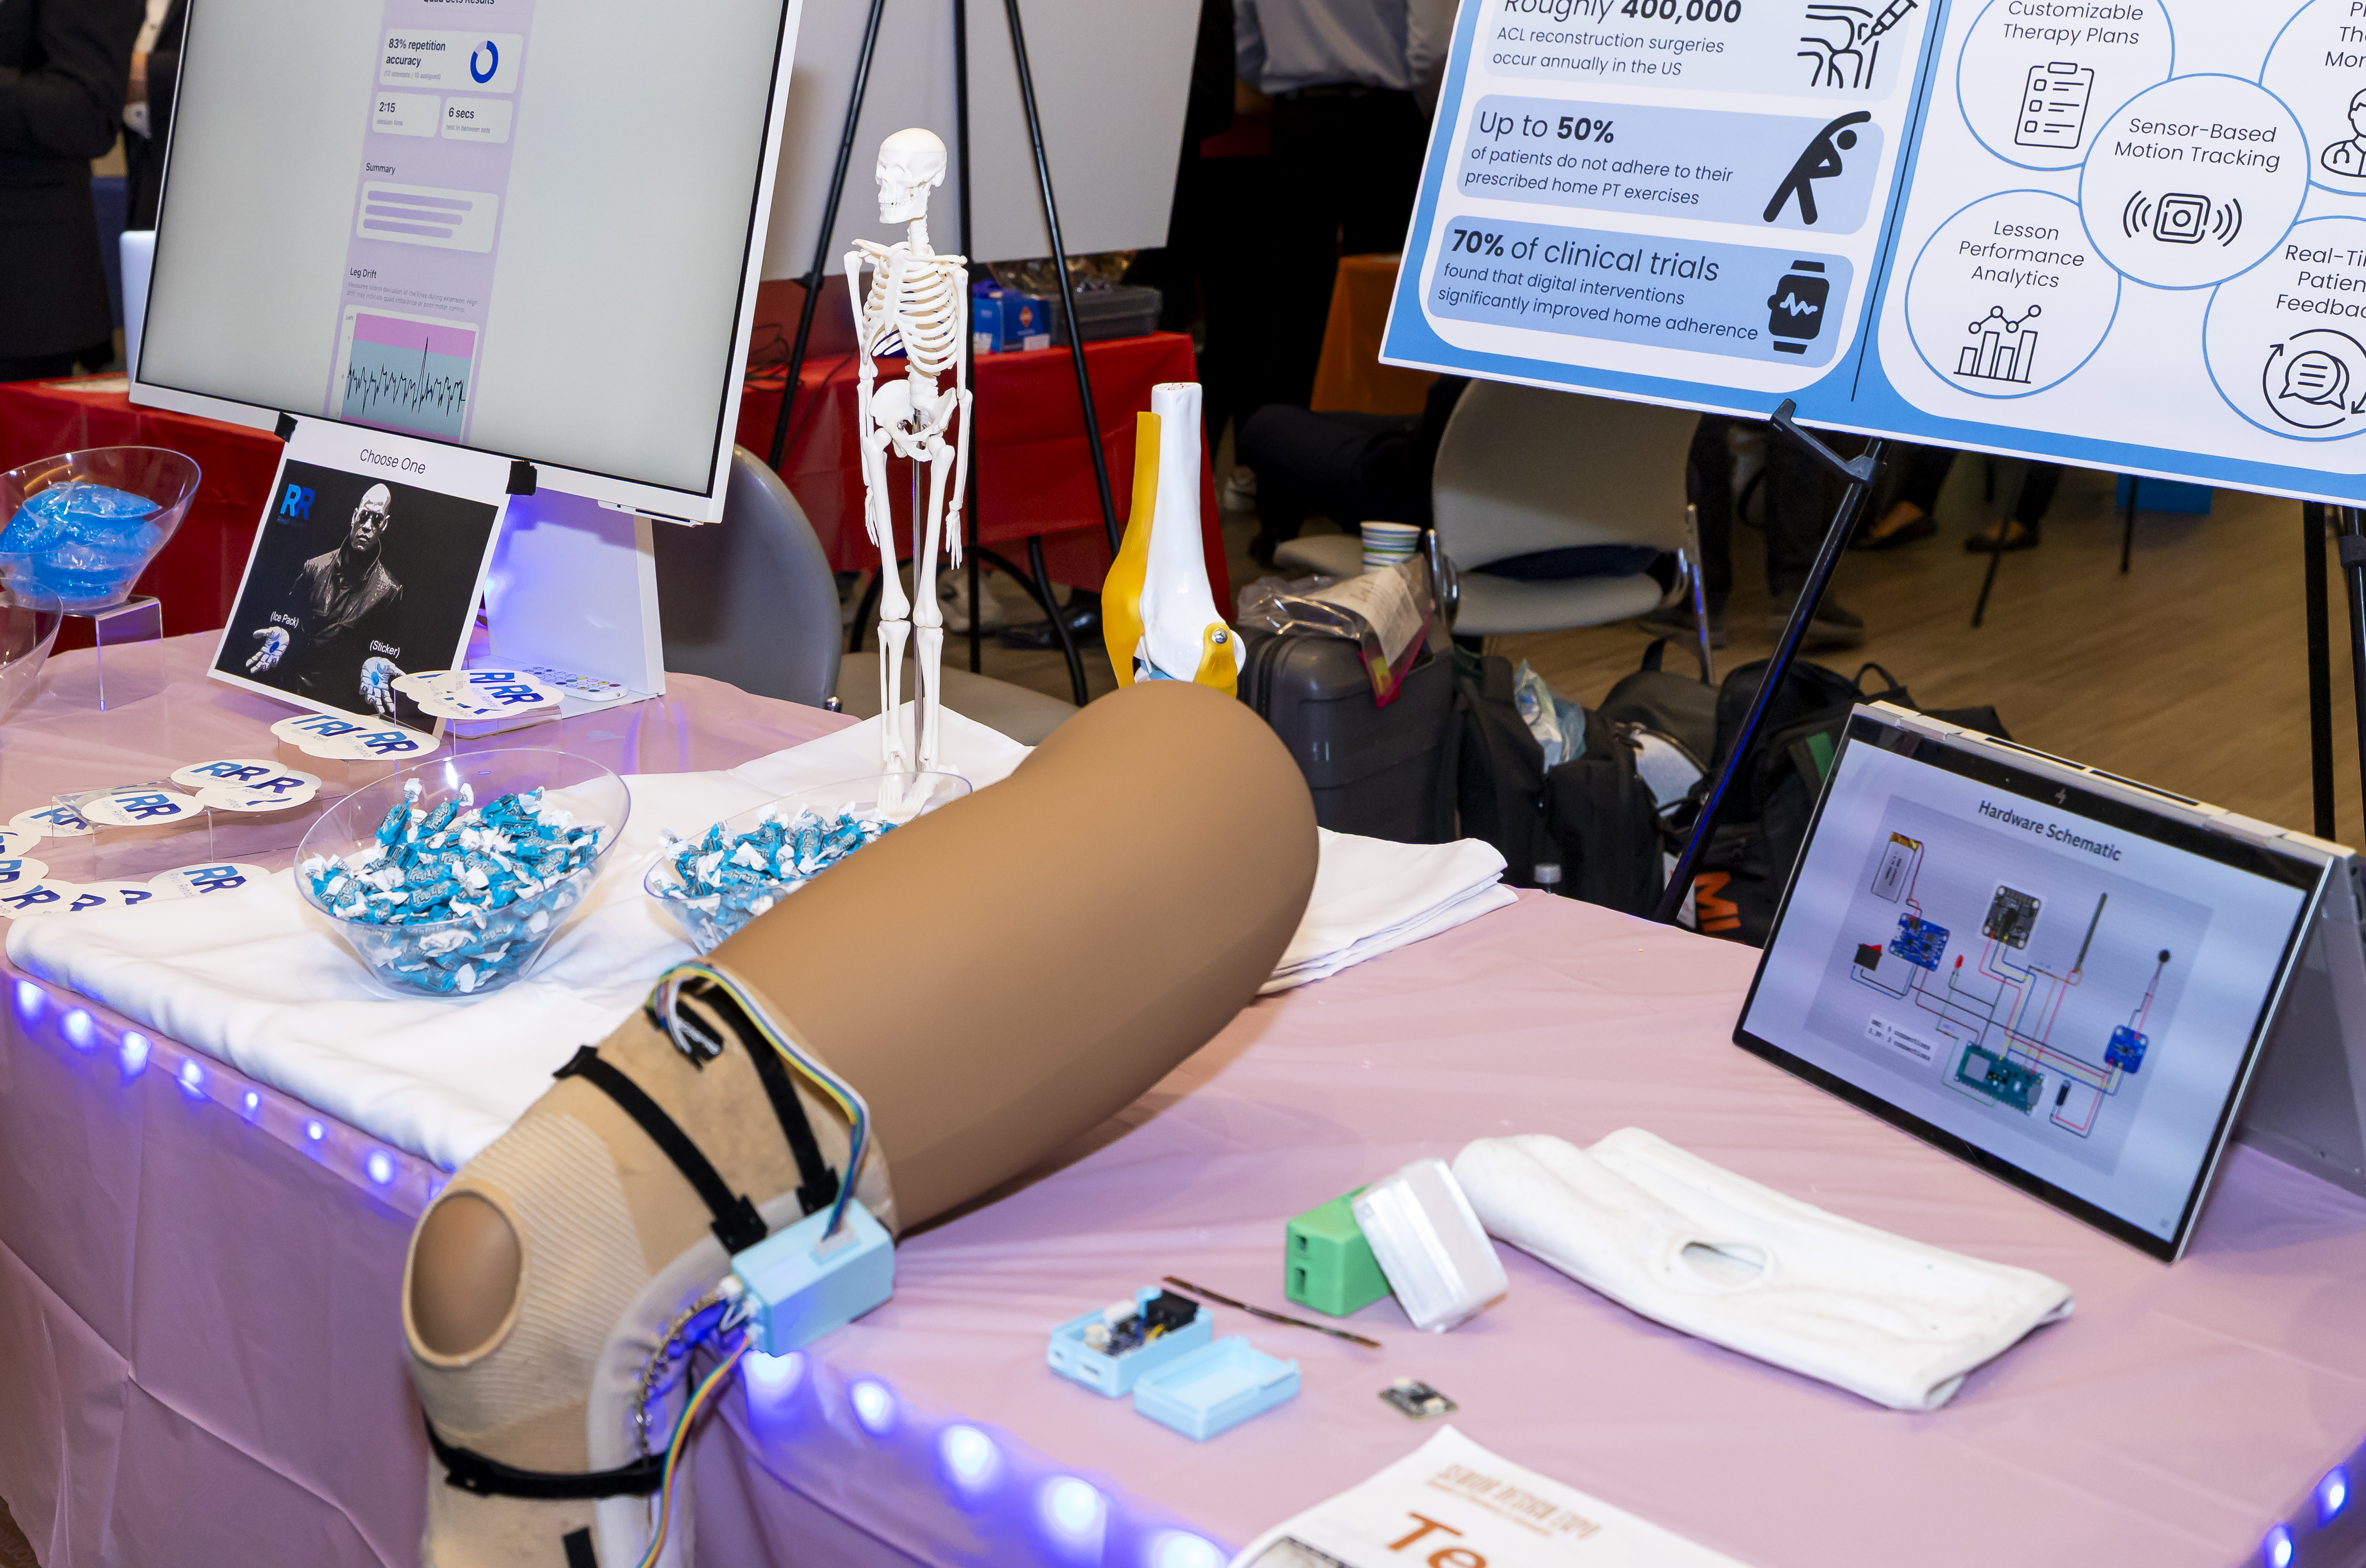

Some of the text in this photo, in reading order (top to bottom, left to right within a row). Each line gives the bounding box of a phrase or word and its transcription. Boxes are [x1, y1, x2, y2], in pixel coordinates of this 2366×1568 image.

[1621, 0, 1741, 23] 400,000
[2009, 0, 2143, 20] Customizable
[389, 38, 446, 52] 83% repetition
[1497, 27, 1724, 55] ACL reconstruction surgeries
[2004, 23, 2139, 46] Therapy Plans
[2340, 26, 2366, 42] Th
[386, 56, 422, 68] accuracy
[1493, 53, 1682, 76] occur annually in the US
[379, 102, 396, 113] 2:15
[449, 107, 474, 119] 6 secs
[1480, 111, 1614, 143] Up to 50%
[2129, 118, 2277, 143] Sensor-Based
[1471, 146, 1733, 182] of patients do not adhere to their
[2115, 141, 2280, 173] Motion Tracking
[366, 163, 396, 175] Summary
[1464, 172, 1699, 204] prescribed home PT exercises
[1994, 221, 2059, 240] Lesson
[1451, 229, 1719, 281] 70% of clinical trials
[1959, 241, 2084, 266] Performance
[2285, 245, 2366, 267] Real-Ti
[350, 267, 377, 279] Leg Drift
[1444, 262, 1685, 305] found that digital interventions
[1971, 266, 2059, 289] Analytics
[1438, 289, 1758, 340] significantly improved home adherence
[360, 449, 425, 474] Choose One
[280, 484, 315, 520] RR
[270, 611, 299, 628] (Ice Pack)
[370, 640, 400, 658] (Sticker)
[483, 684, 545, 705] RR
[356, 731, 419, 755] RR
[189, 762, 271, 781] RR
[210, 778, 243, 786] Rehab
[114, 794, 182, 820] RR
[1978, 801, 2121, 861] Hardware Schematic
[182, 866, 247, 894] RR
